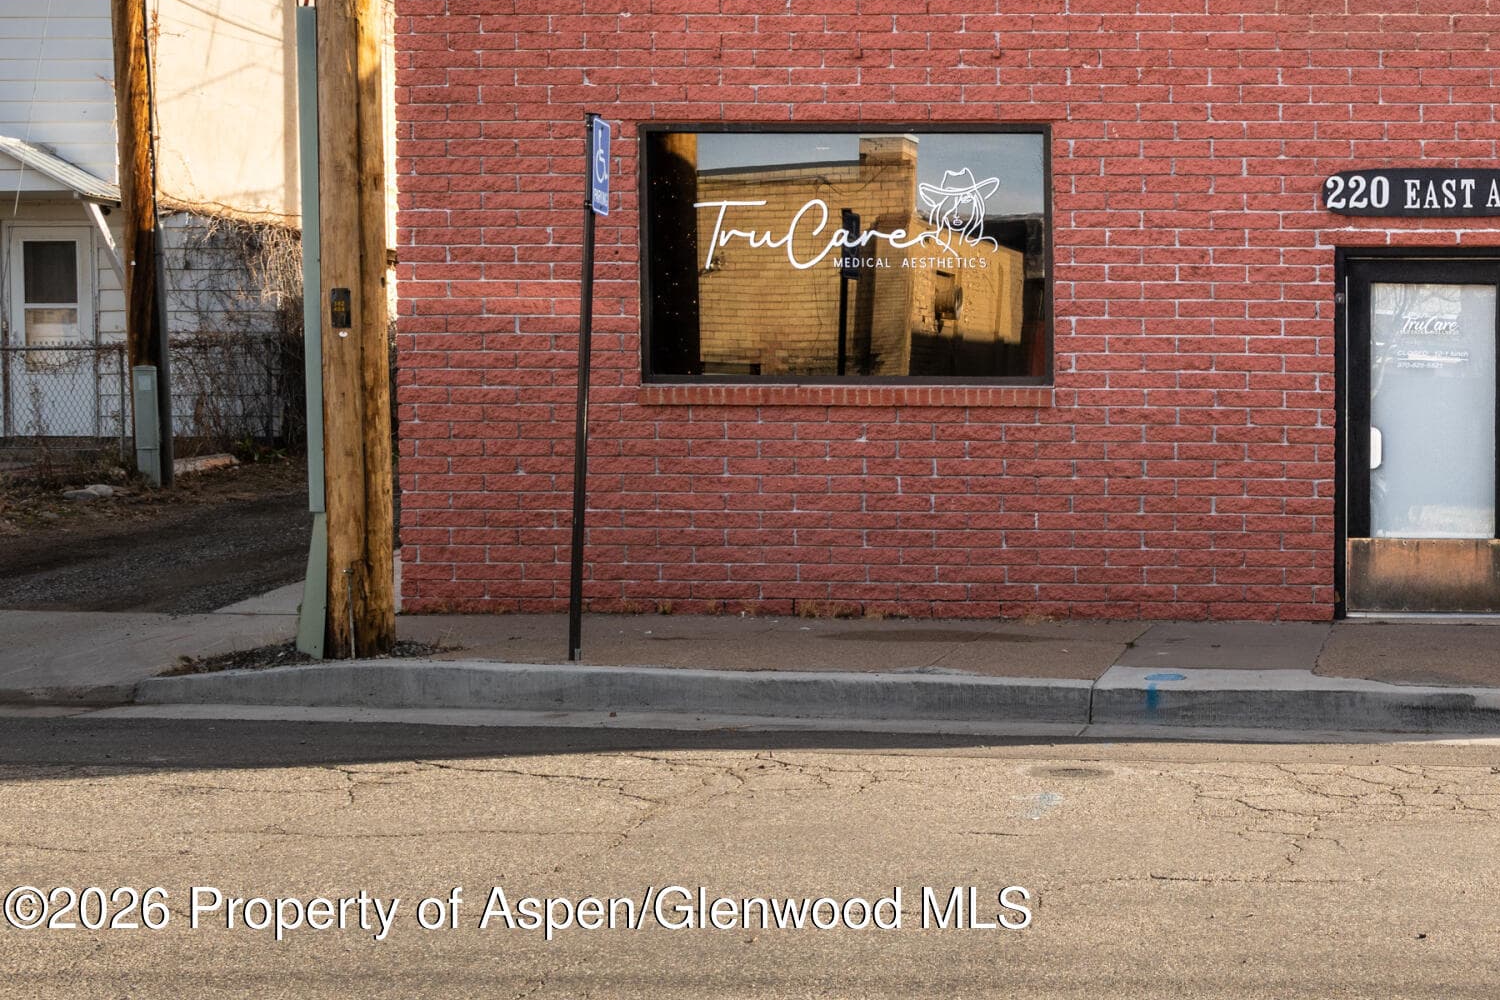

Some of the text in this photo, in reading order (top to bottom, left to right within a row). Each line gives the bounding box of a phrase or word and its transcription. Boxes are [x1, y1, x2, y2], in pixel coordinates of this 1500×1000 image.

[1326, 176, 1390, 208] 220
[1404, 179, 1476, 209] EAST
[693, 199, 932, 269] TruCare
[833, 256, 987, 269] MEDICAL AESTHETICS
[1401, 314, 1459, 335] TruCare
